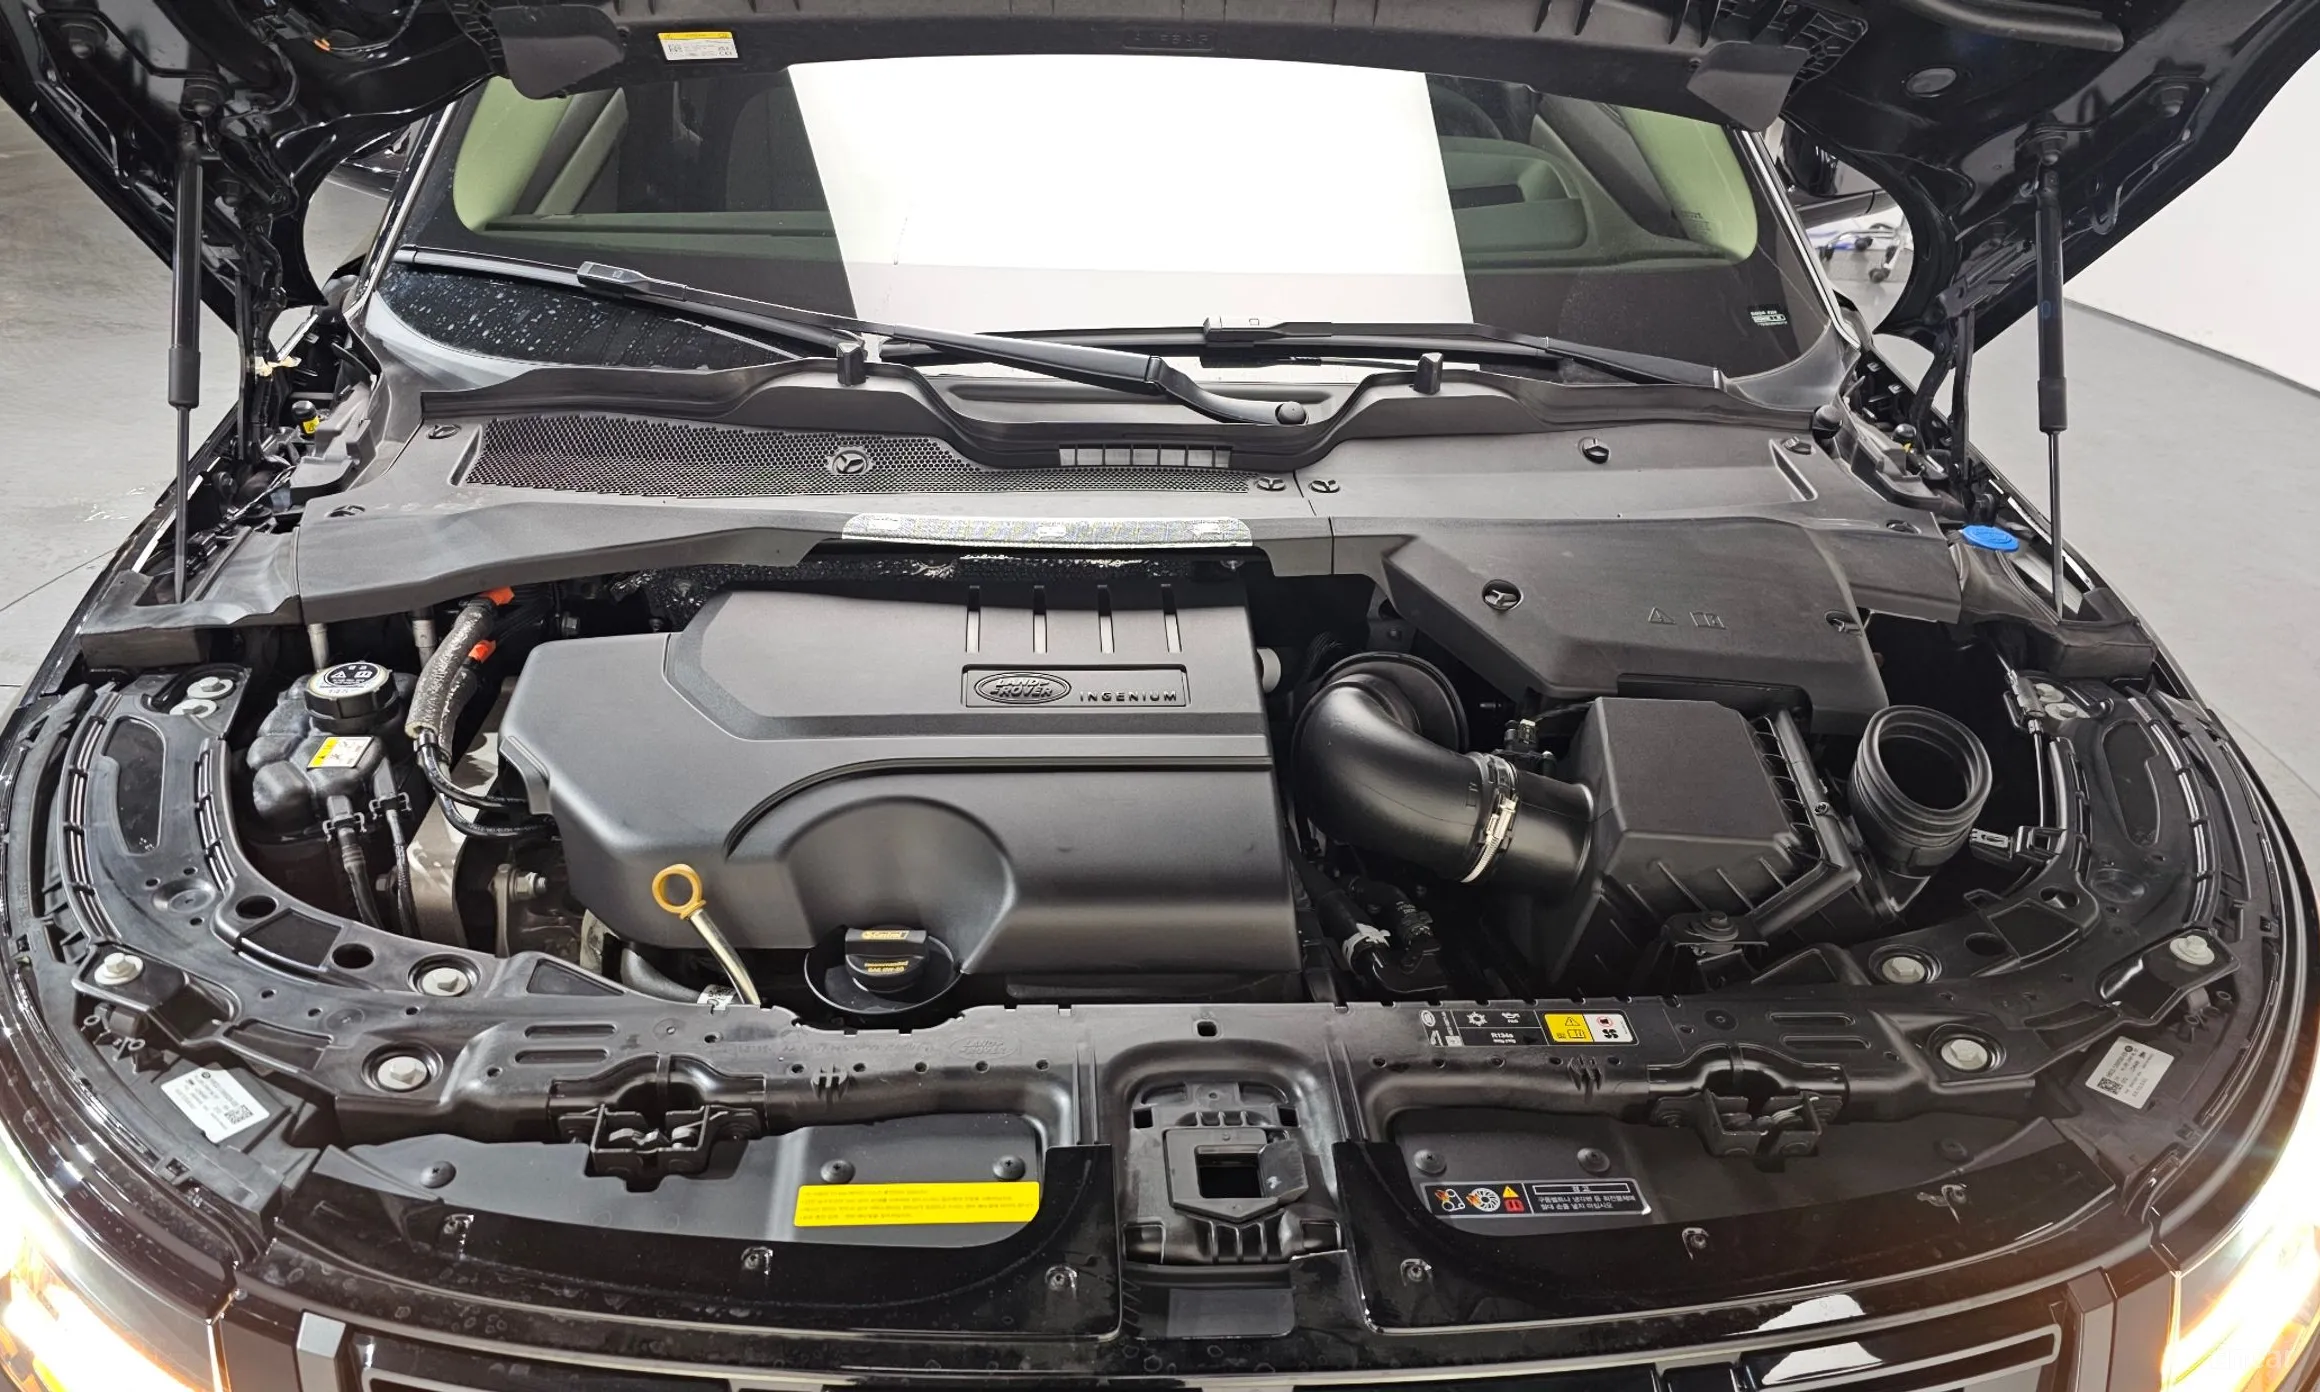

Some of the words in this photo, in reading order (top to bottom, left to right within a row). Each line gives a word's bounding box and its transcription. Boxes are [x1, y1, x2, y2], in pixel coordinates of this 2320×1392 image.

[996, 678, 1046, 687] LAND
[997, 686, 1053, 698] ROVER
[1079, 690, 1178, 702] INGENIUM
